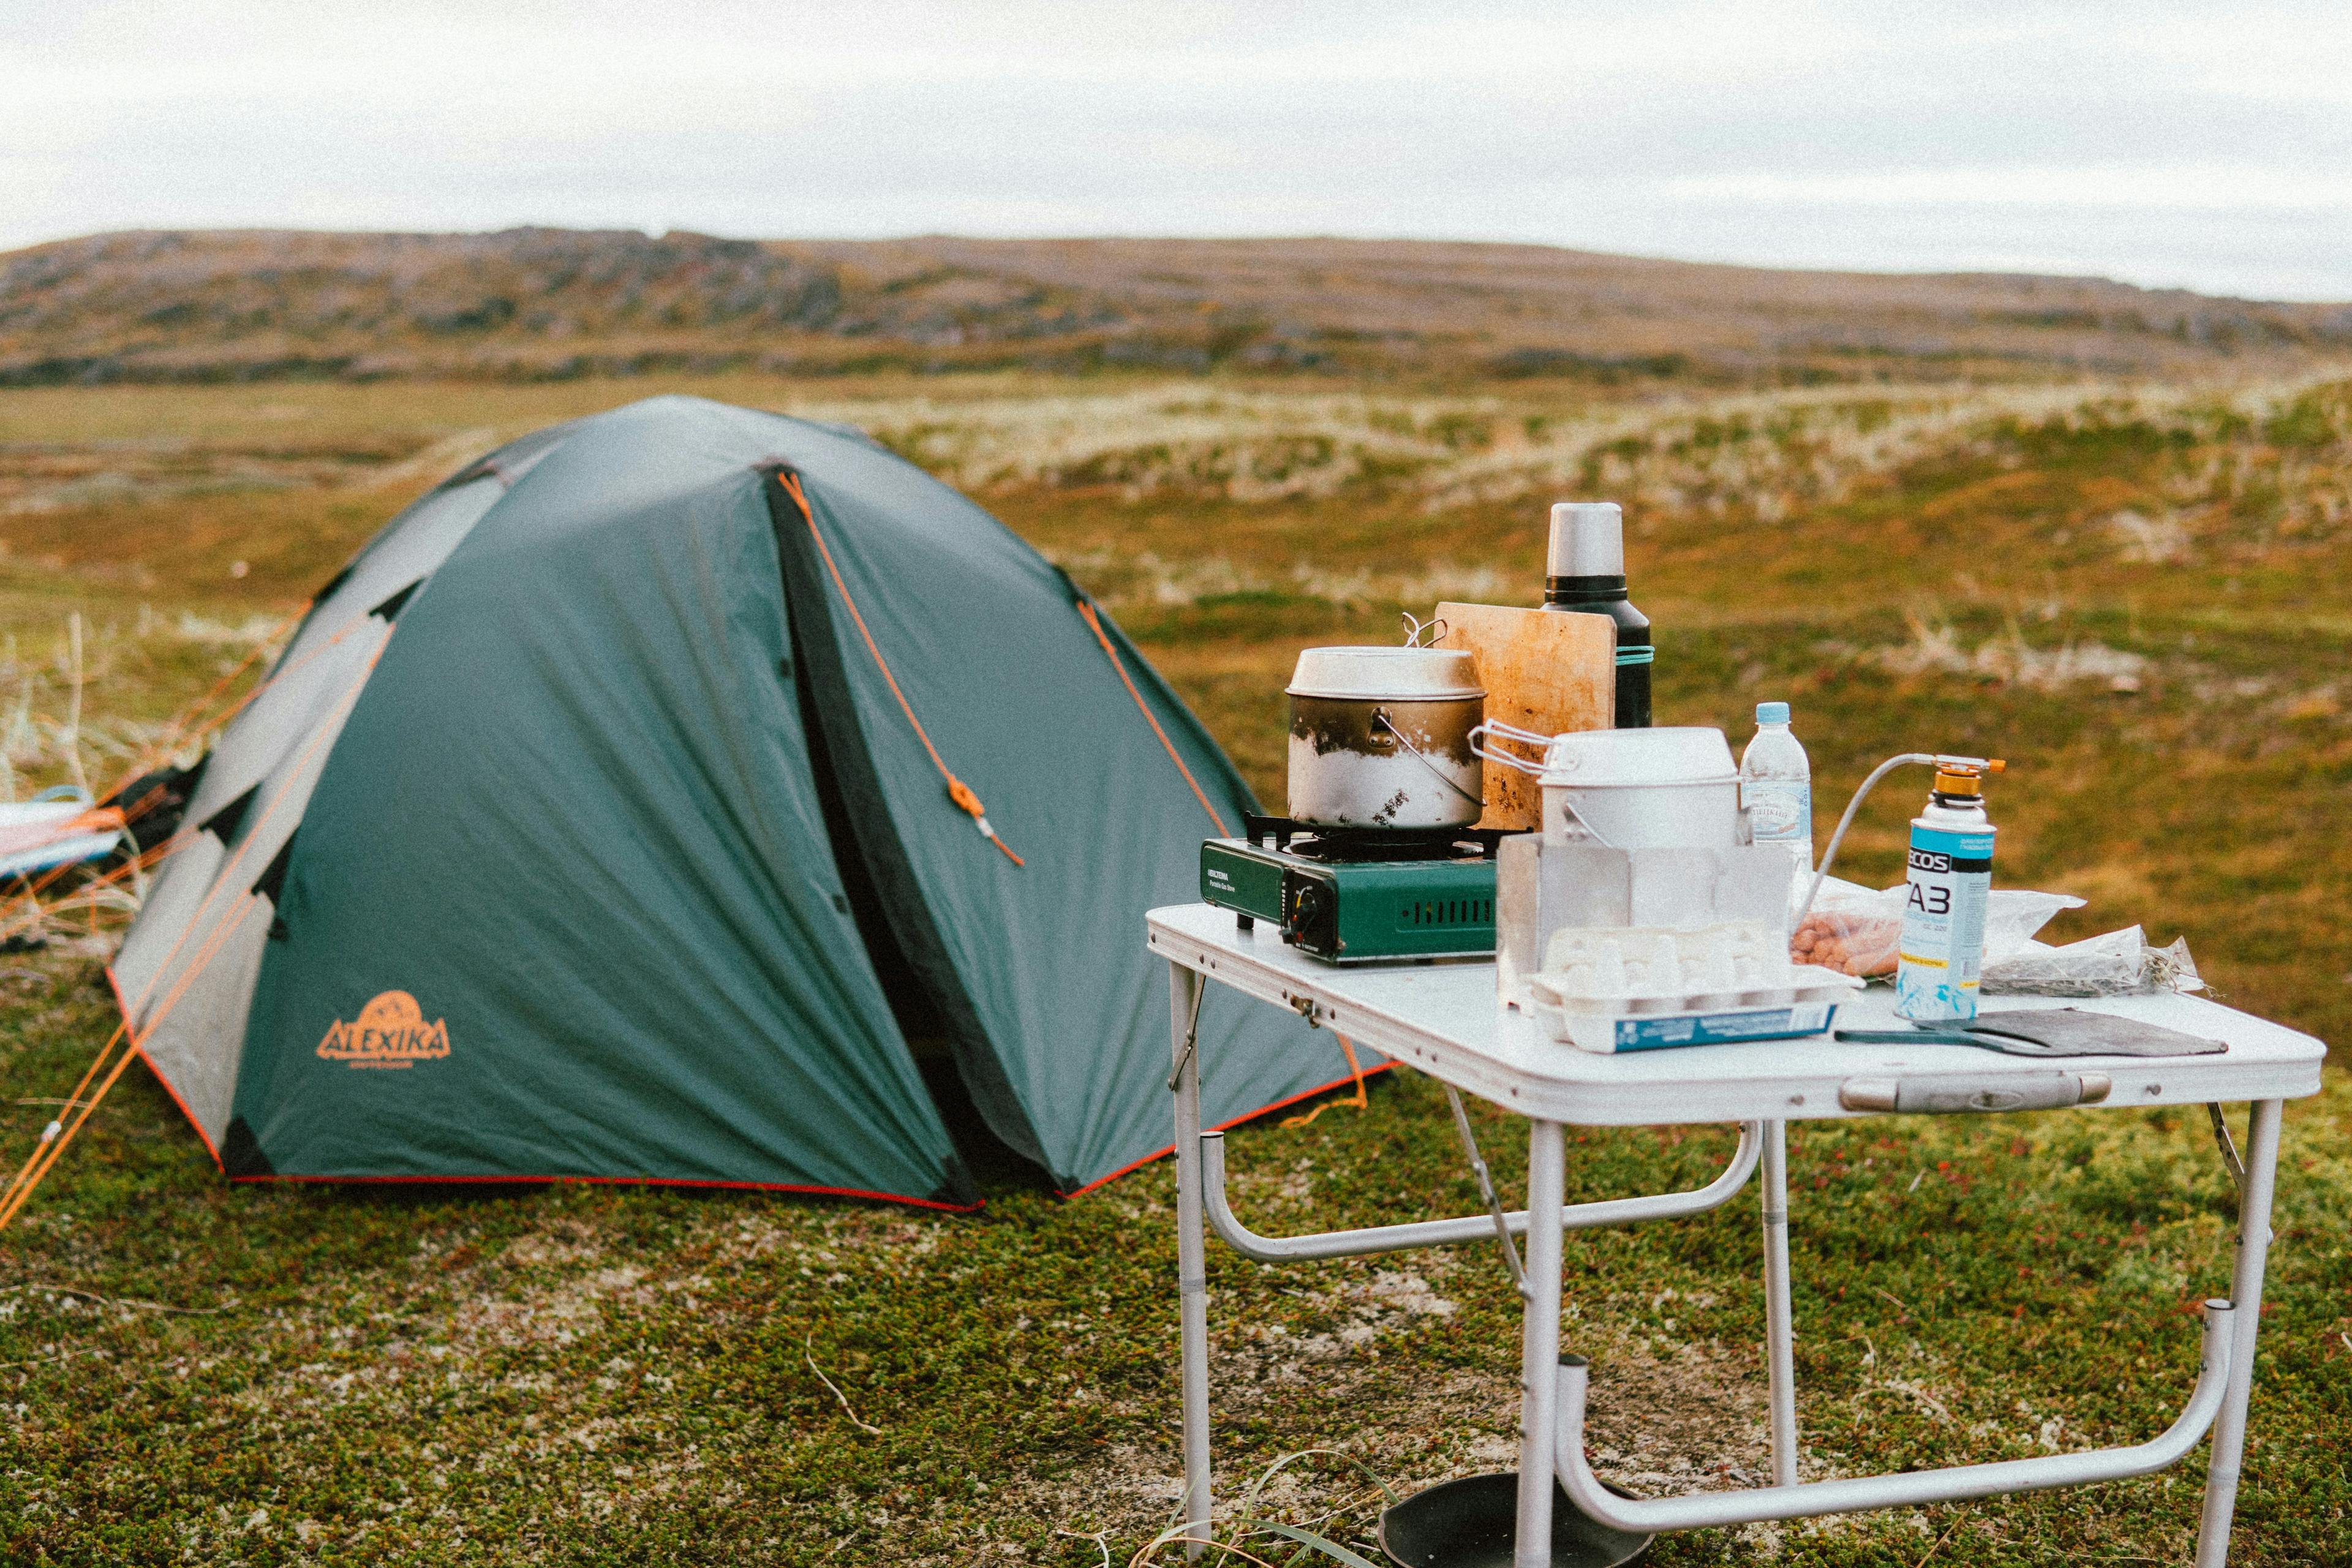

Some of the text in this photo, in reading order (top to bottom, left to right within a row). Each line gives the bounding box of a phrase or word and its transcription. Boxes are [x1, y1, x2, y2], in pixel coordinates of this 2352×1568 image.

[1208, 869, 1228, 881] BILTEMA
[1210, 880, 1221, 888] Portable
[322, 1023, 447, 1055] ALEXIKA
